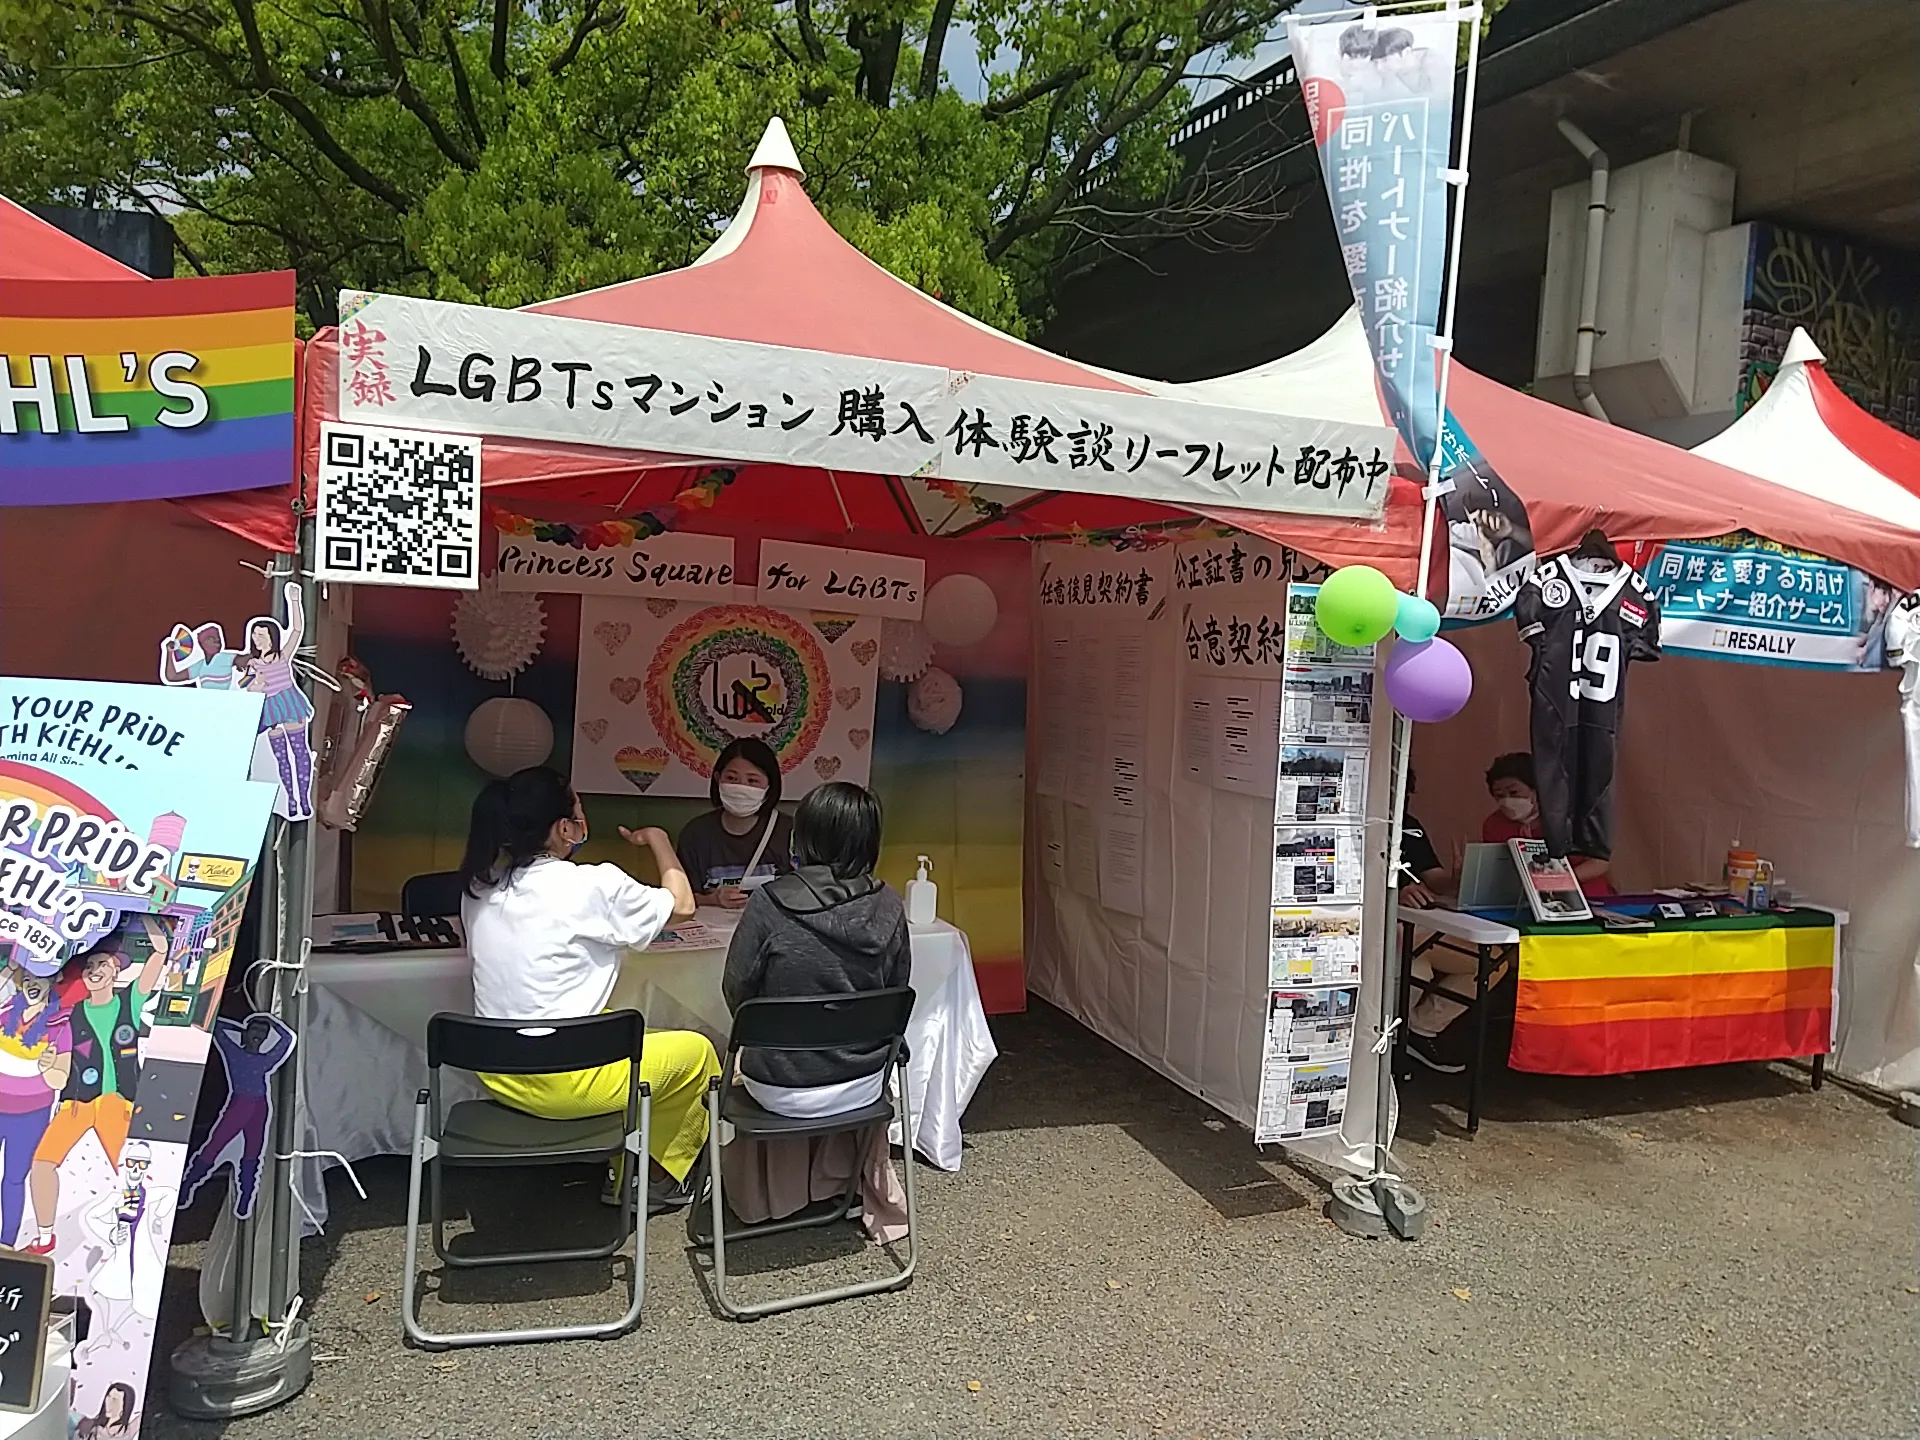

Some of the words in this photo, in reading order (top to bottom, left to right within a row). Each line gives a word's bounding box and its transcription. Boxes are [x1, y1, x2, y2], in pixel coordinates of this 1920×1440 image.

[343, 318, 396, 407] 実録
[498, 545, 615, 579] Princess
[626, 551, 733, 586] Square
[765, 561, 810, 591] for
[823, 571, 917, 603] LGBTs
[1658, 552, 1844, 596] 同性を愛する方向け
[1041, 567, 1154, 607] 任意後見契約書
[1654, 585, 1846, 626] パートナー紹介サービス
[1727, 629, 1796, 655] RESALLY
[12, 695, 94, 725] YOUR
[40, 751, 58, 764] All
[24, 924, 57, 953] 1851
